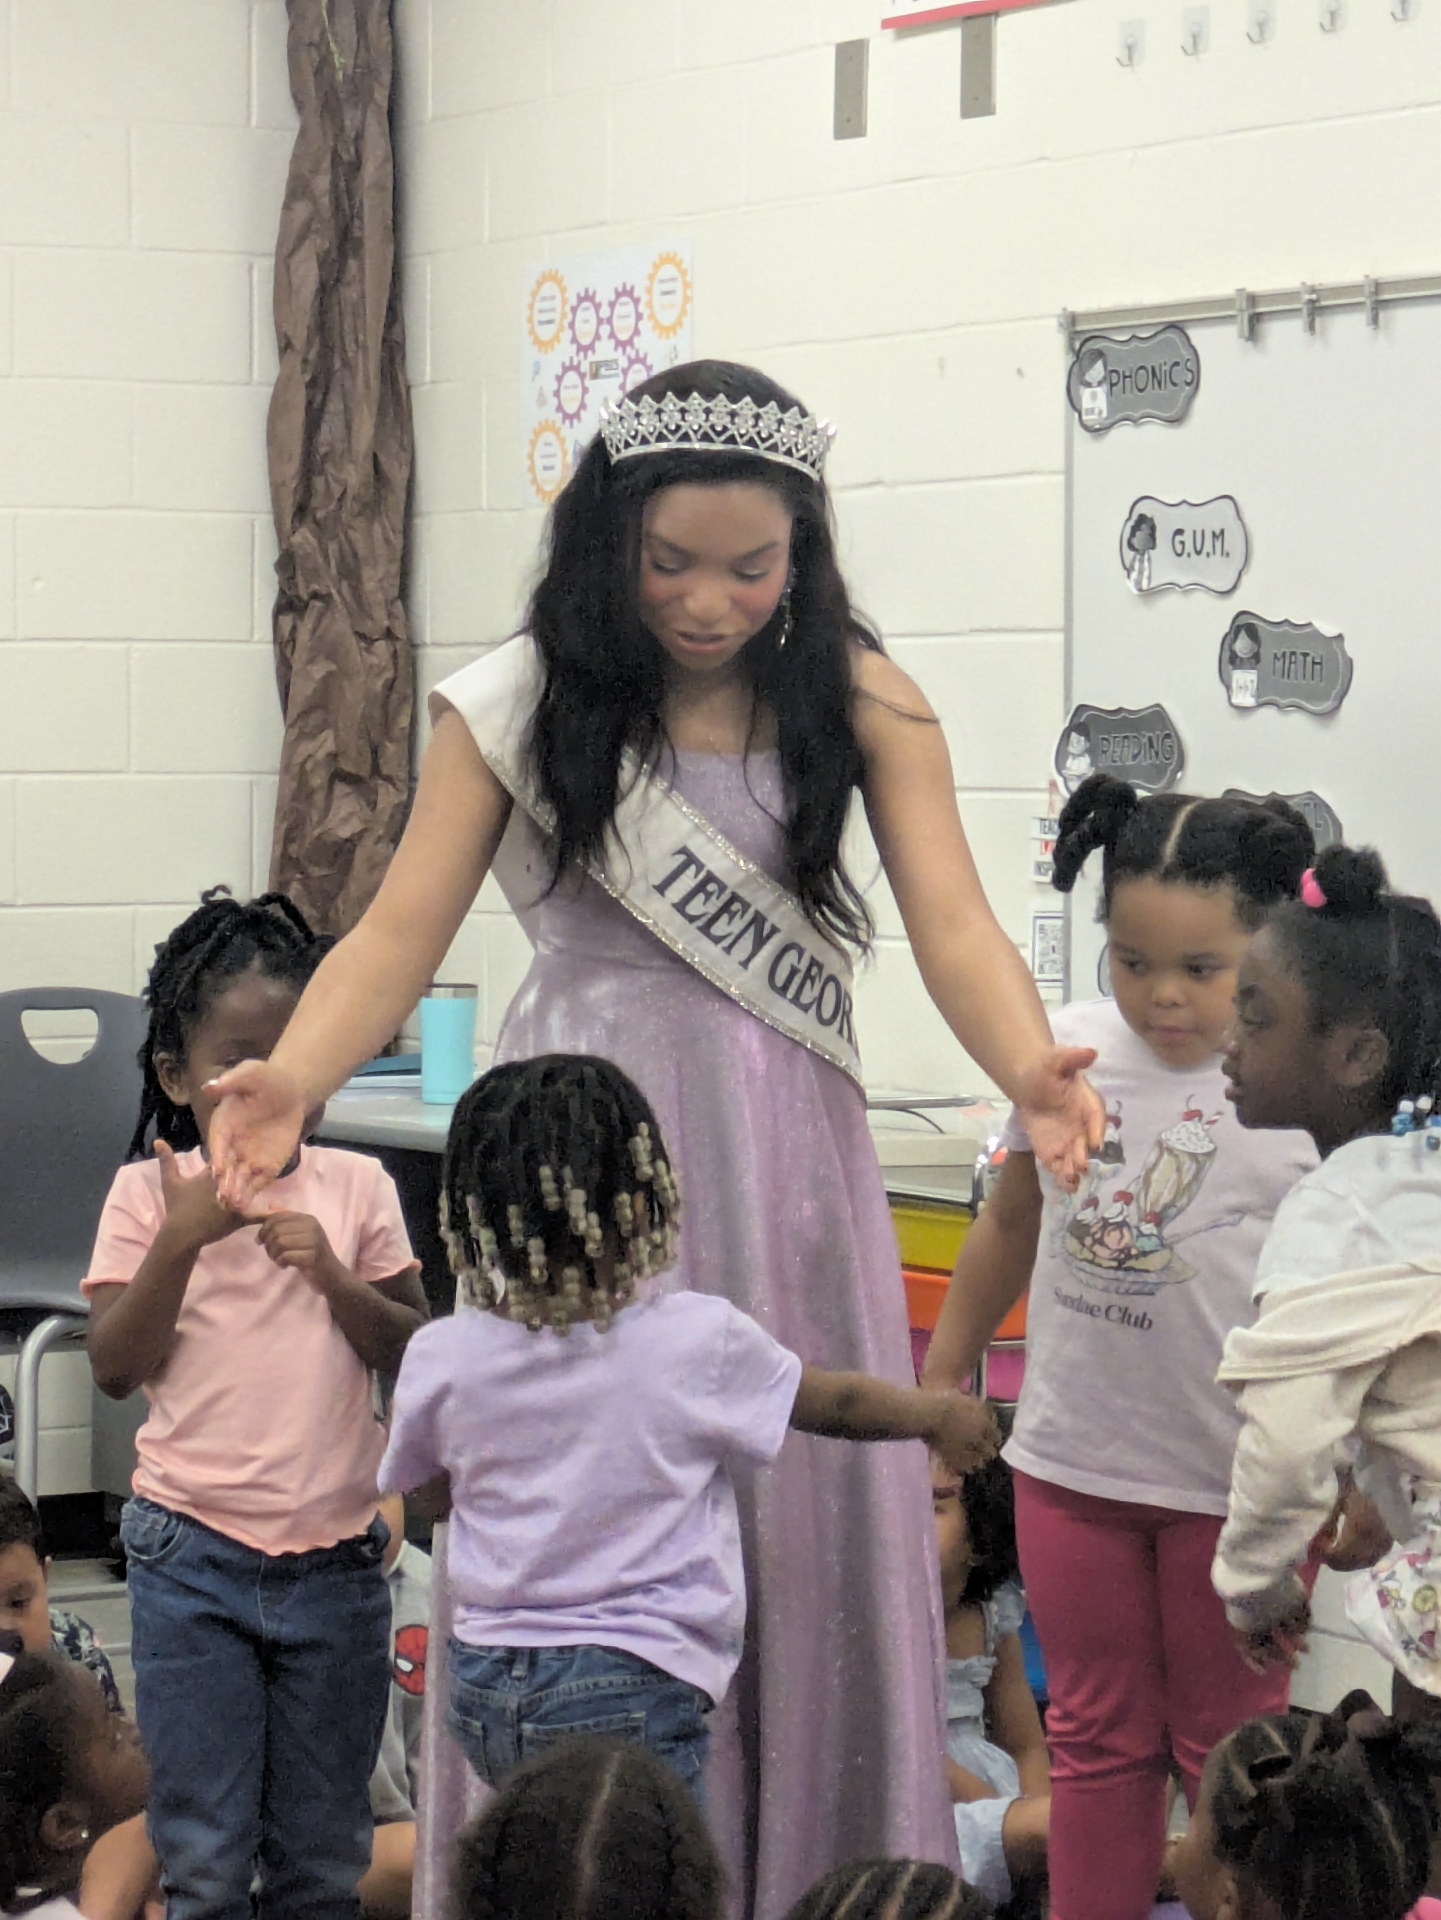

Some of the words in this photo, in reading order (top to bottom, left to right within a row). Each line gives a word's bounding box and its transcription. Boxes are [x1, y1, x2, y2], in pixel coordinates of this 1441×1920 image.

[1172, 528, 1230, 558] G.U.M.
[1273, 651, 1324, 683] MATH
[652, 845, 781, 970] TEEN
[1105, 1304, 1153, 1330] Club
